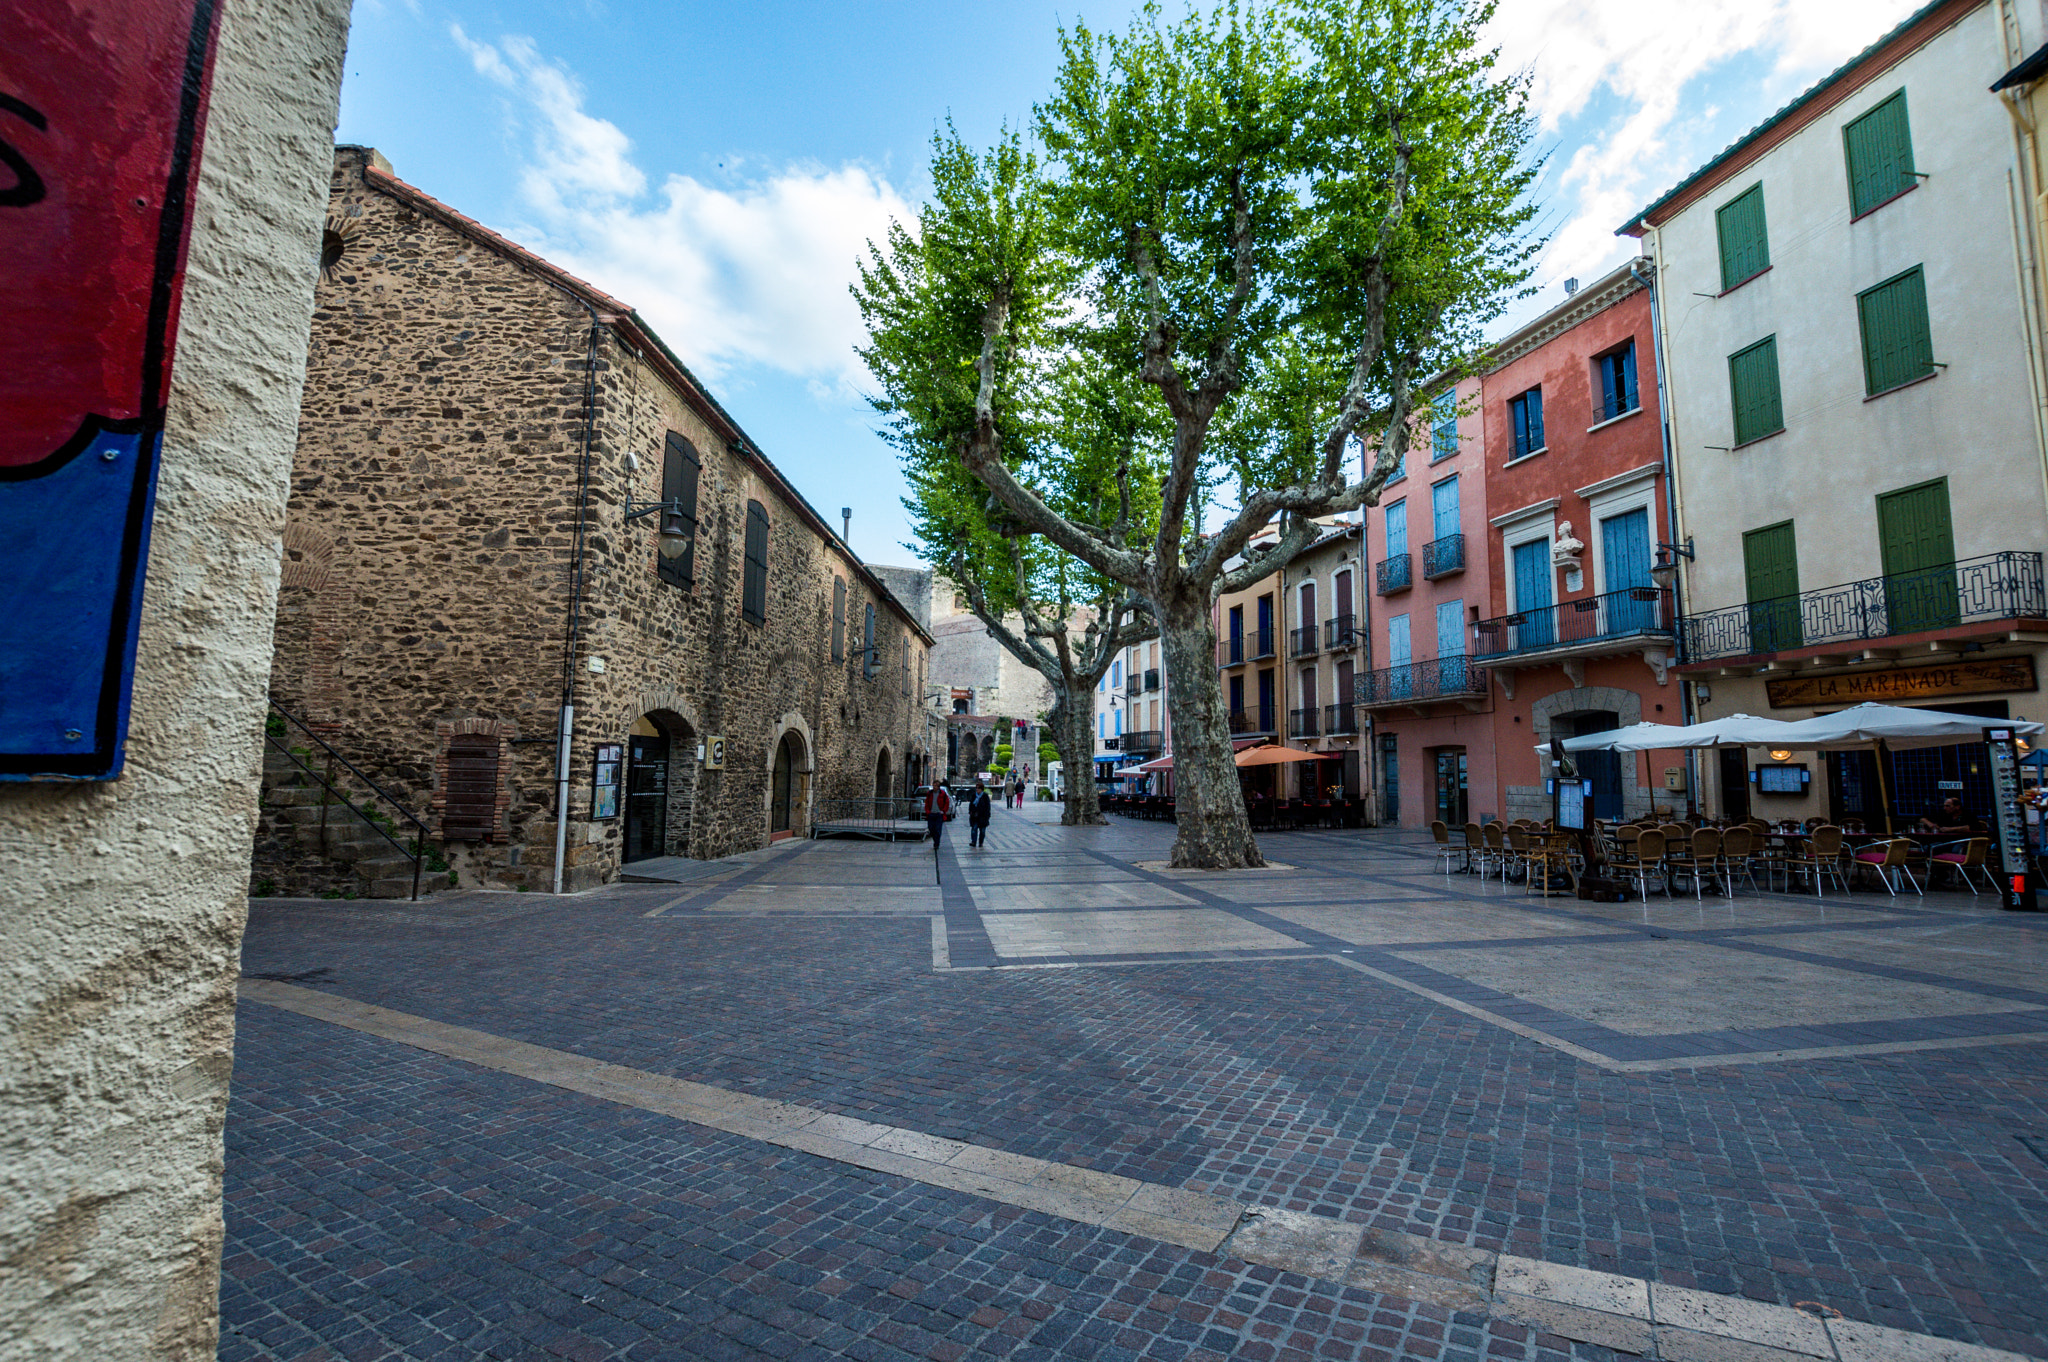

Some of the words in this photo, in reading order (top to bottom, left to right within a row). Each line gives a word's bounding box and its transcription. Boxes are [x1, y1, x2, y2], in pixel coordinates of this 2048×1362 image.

[1818, 680, 1838, 696] LA
[1848, 668, 1960, 694] MARINADE
[1964, 665, 2026, 688] GRILLADES
